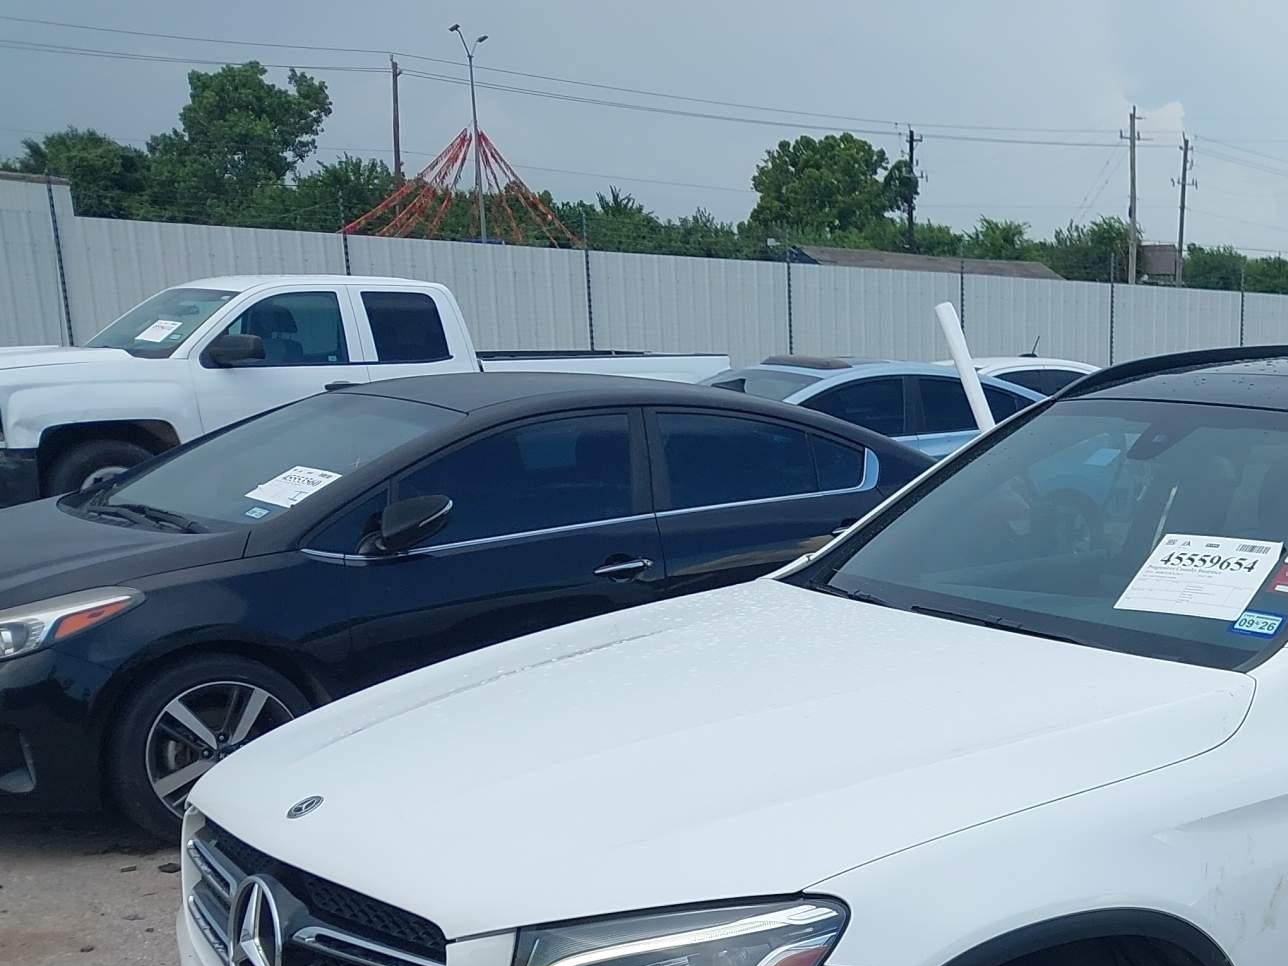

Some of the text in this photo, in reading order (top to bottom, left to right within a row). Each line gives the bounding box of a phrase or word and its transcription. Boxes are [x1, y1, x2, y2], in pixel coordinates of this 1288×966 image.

[1160, 551, 1259, 573] 45559654
[1238, 617, 1255, 628] 09
[1258, 621, 1277, 632] 26
